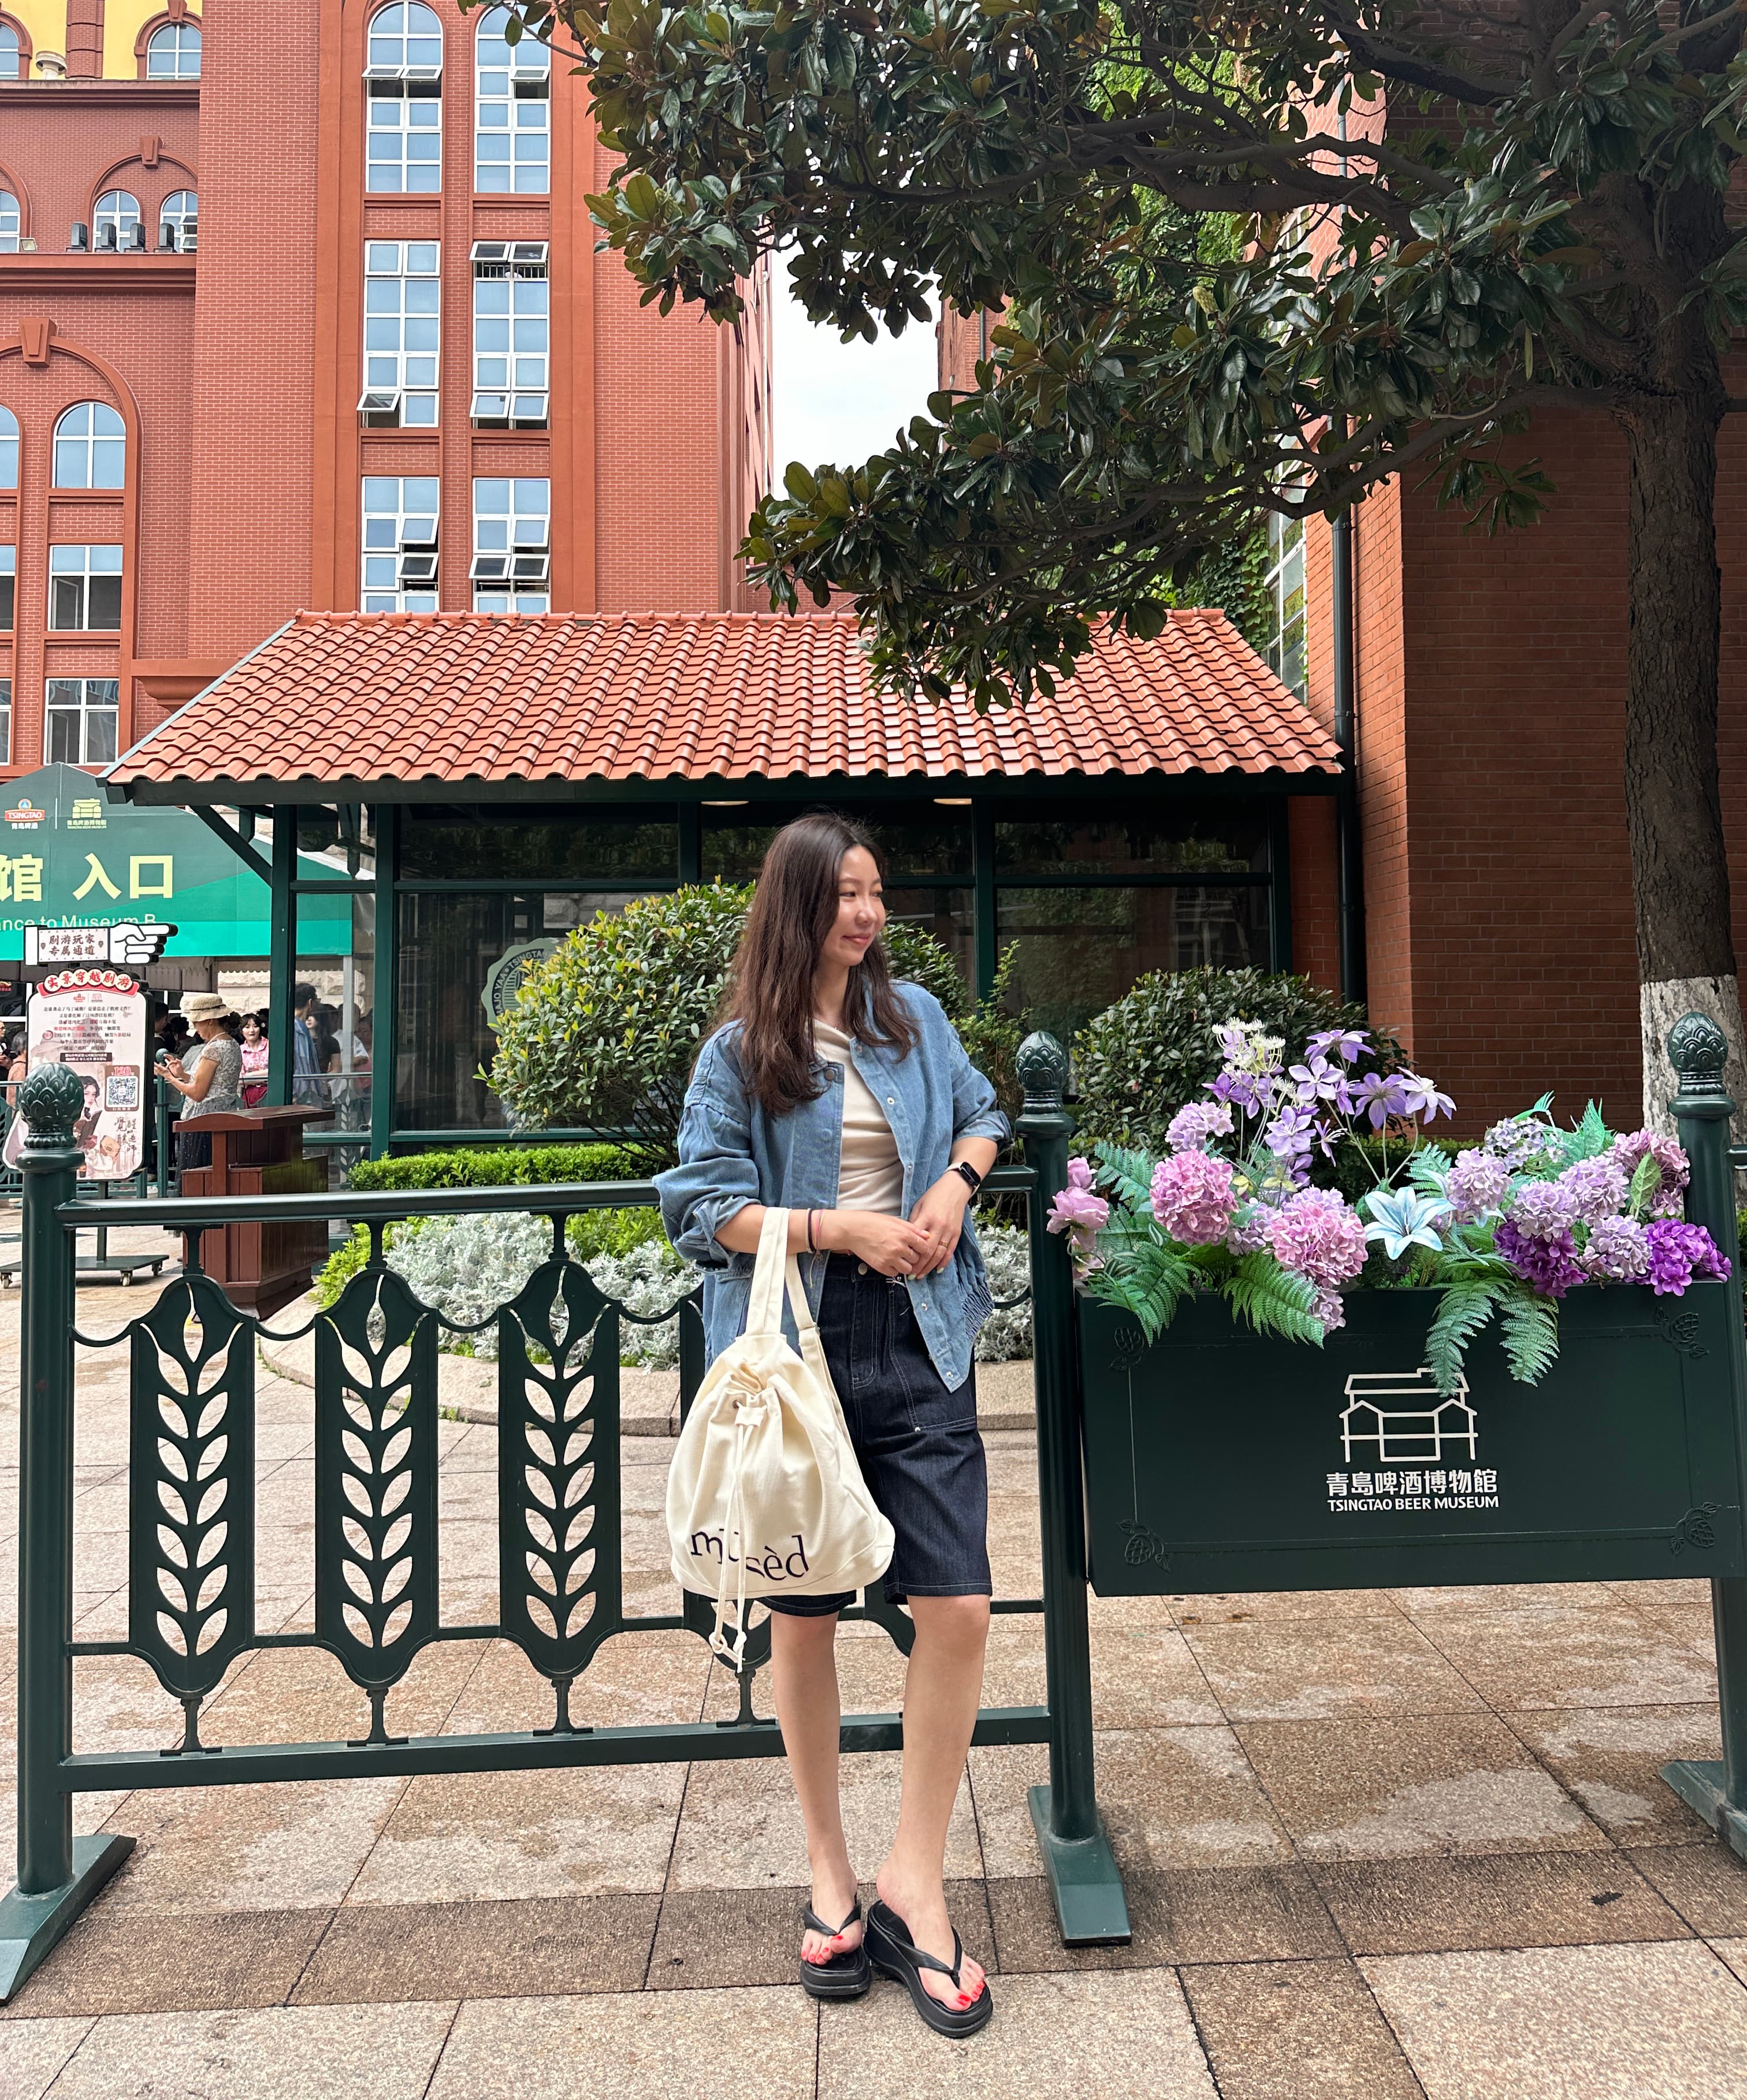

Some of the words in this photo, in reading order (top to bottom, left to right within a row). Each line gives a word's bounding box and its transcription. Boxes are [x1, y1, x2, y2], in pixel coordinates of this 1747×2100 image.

[72, 852, 173, 901] 入口
[0, 919, 35, 930] nce
[40, 915, 57, 928] to
[49, 933, 95, 945] 剧游玩家
[49, 945, 95, 956] 专属通道
[48, 970, 131, 989] 实景穿越剧游
[1326, 1468, 1497, 1497] 青島啤酒博物館
[1327, 1499, 1391, 1511] TSINGTAO
[1395, 1498, 1432, 1510] BEER
[1434, 1496, 1499, 1509] MUSEUM
